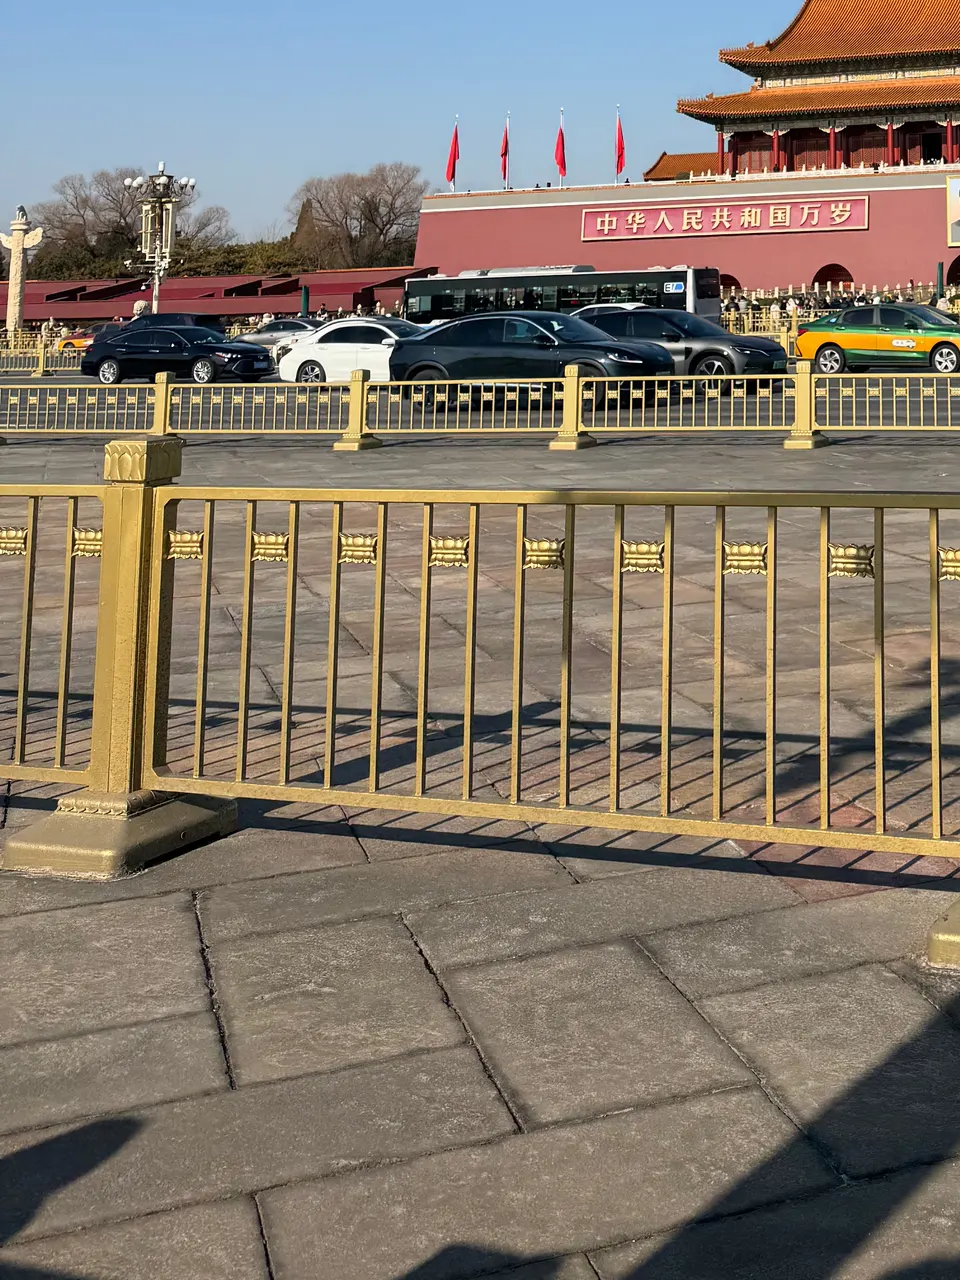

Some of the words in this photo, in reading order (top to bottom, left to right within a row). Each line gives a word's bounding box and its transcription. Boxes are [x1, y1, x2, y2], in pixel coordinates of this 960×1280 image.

[596, 202, 853, 235] 中华人民共和国万岁
